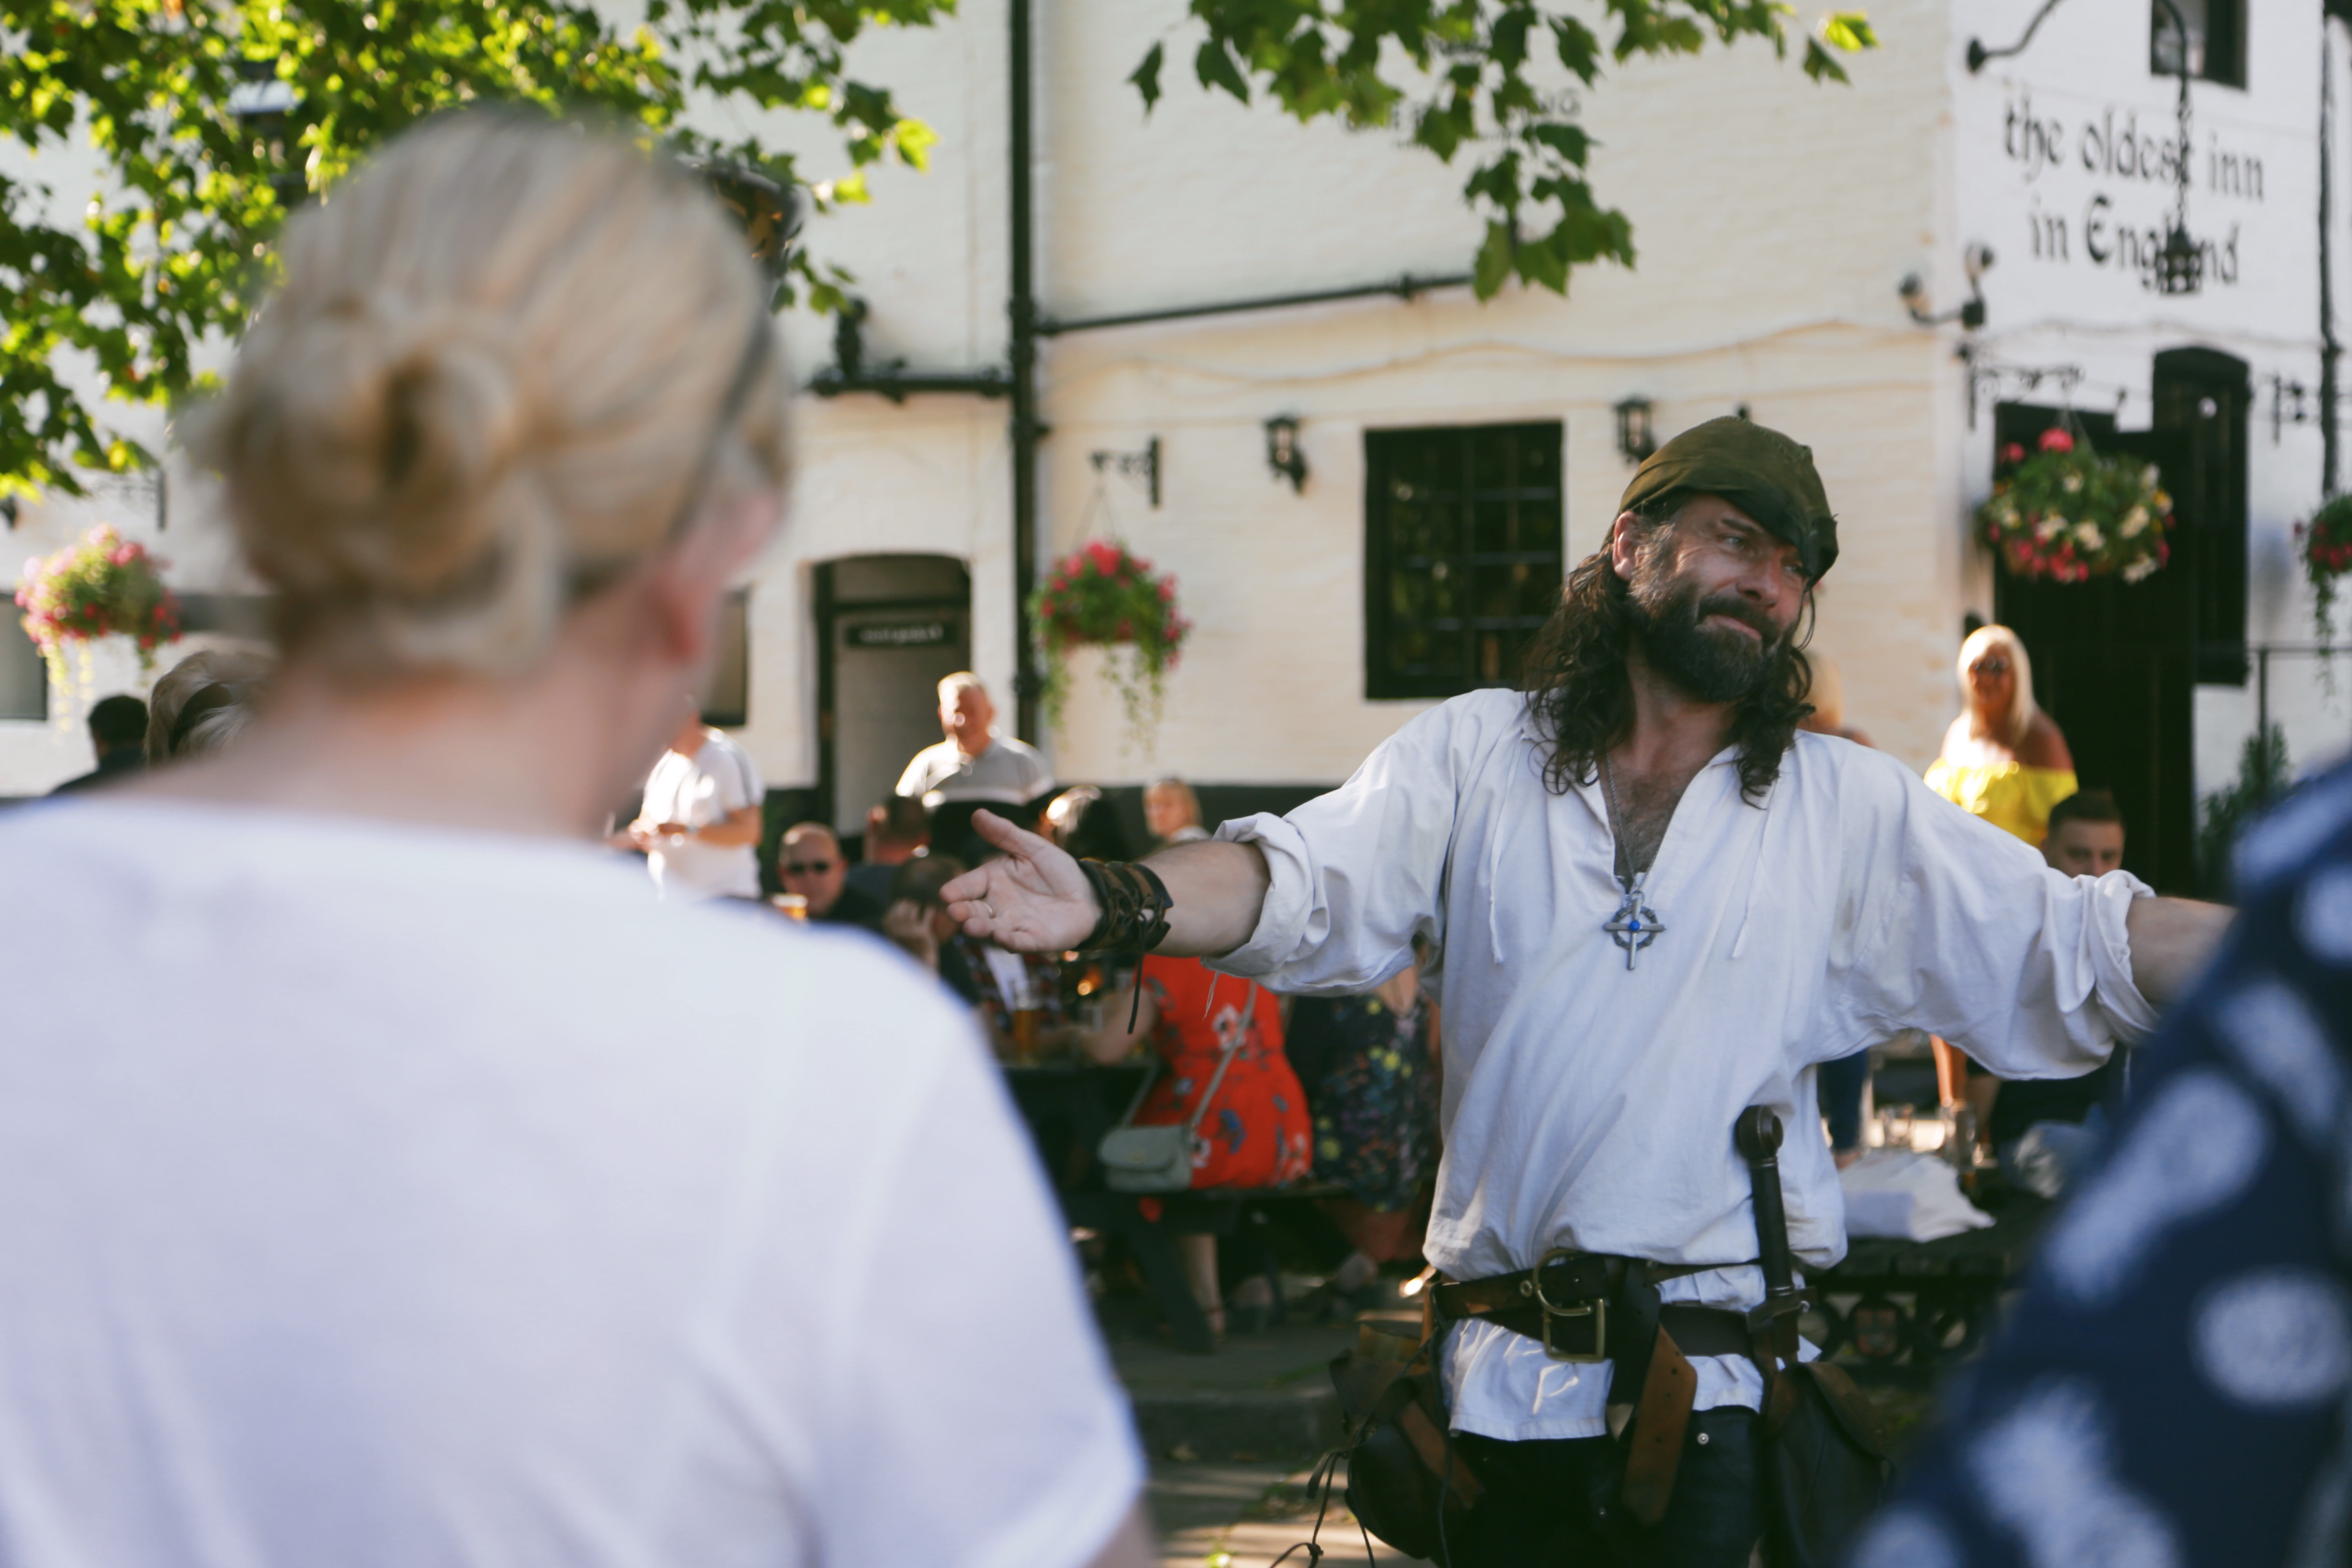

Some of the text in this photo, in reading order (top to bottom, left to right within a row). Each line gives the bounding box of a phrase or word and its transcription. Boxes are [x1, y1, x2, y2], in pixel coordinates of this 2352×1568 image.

[2004, 91, 2065, 183] the
[2208, 130, 2264, 202] inn
[2029, 194, 2069, 263] in
